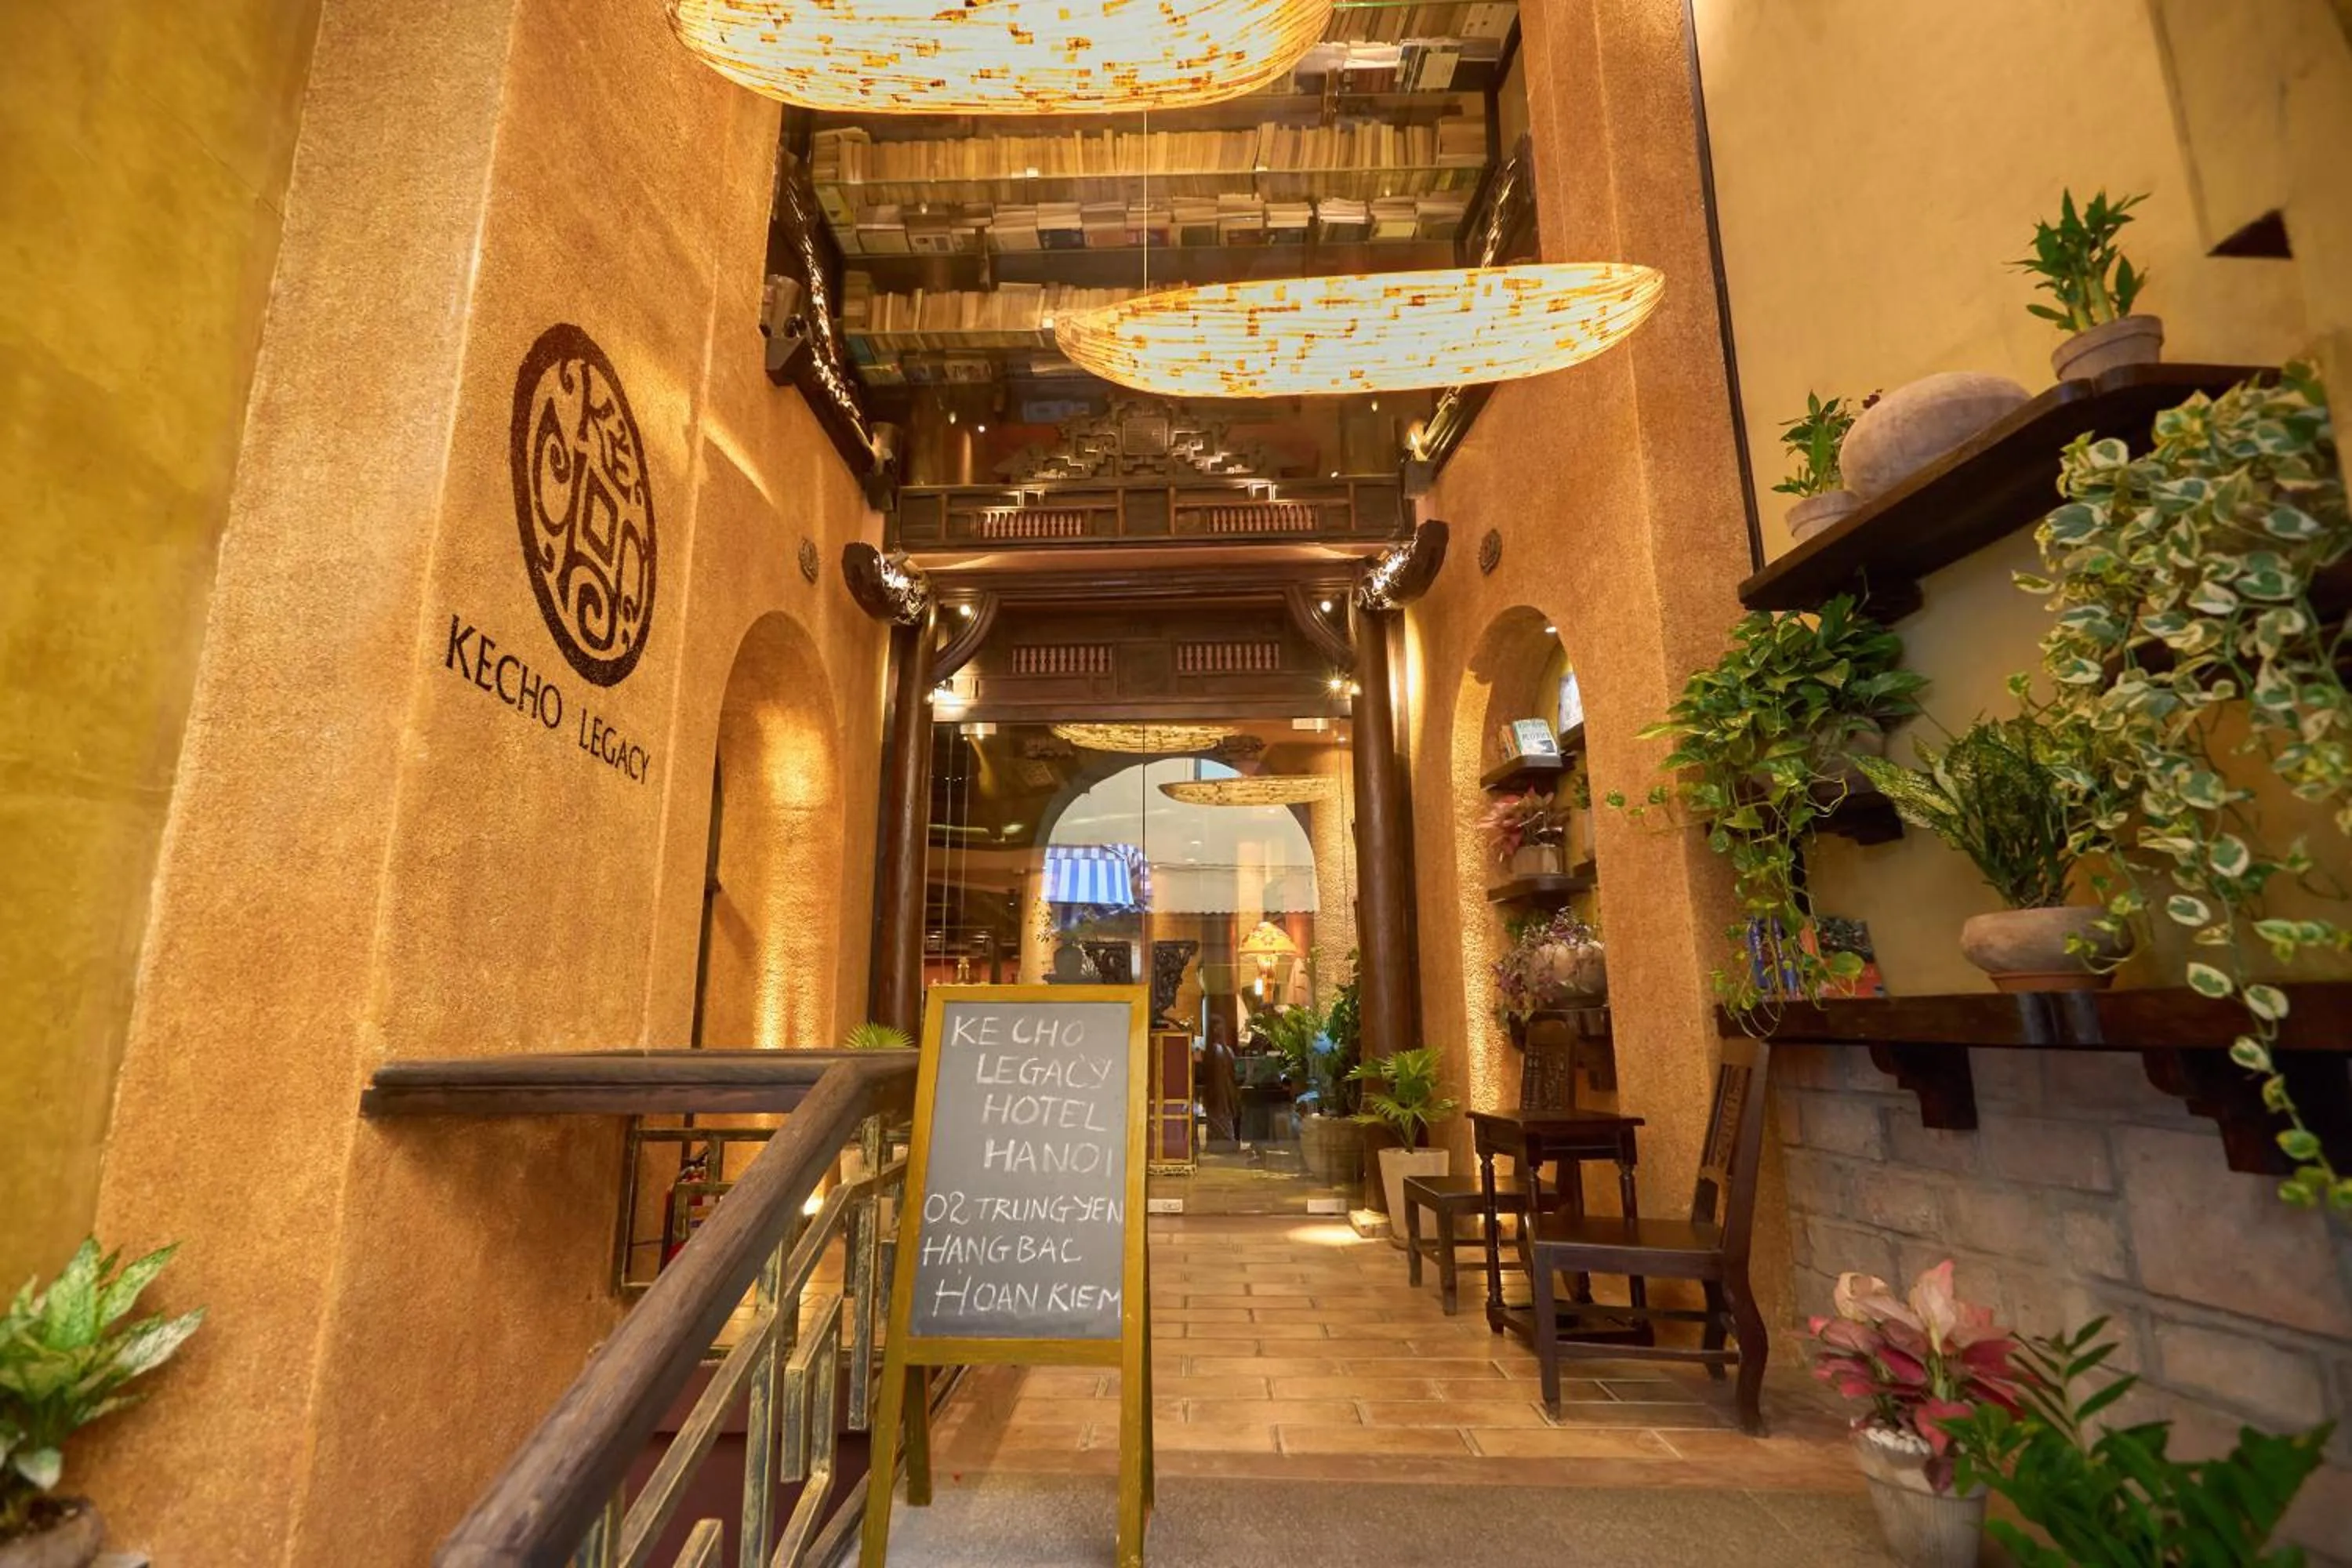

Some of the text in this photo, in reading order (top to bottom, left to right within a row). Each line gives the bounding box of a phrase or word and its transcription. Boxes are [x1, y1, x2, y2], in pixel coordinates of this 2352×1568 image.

[445, 613, 651, 785] KECHO LEGACY
[951, 1015, 1084, 1047] KE CHO
[976, 1053, 1113, 1089] LEGACY
[982, 1094, 1107, 1131] HOTEL
[983, 1138, 1112, 1176] HANOI
[1016, 1234, 1083, 1264] BAC
[931, 1275, 1122, 1318] HOAN KIEM
